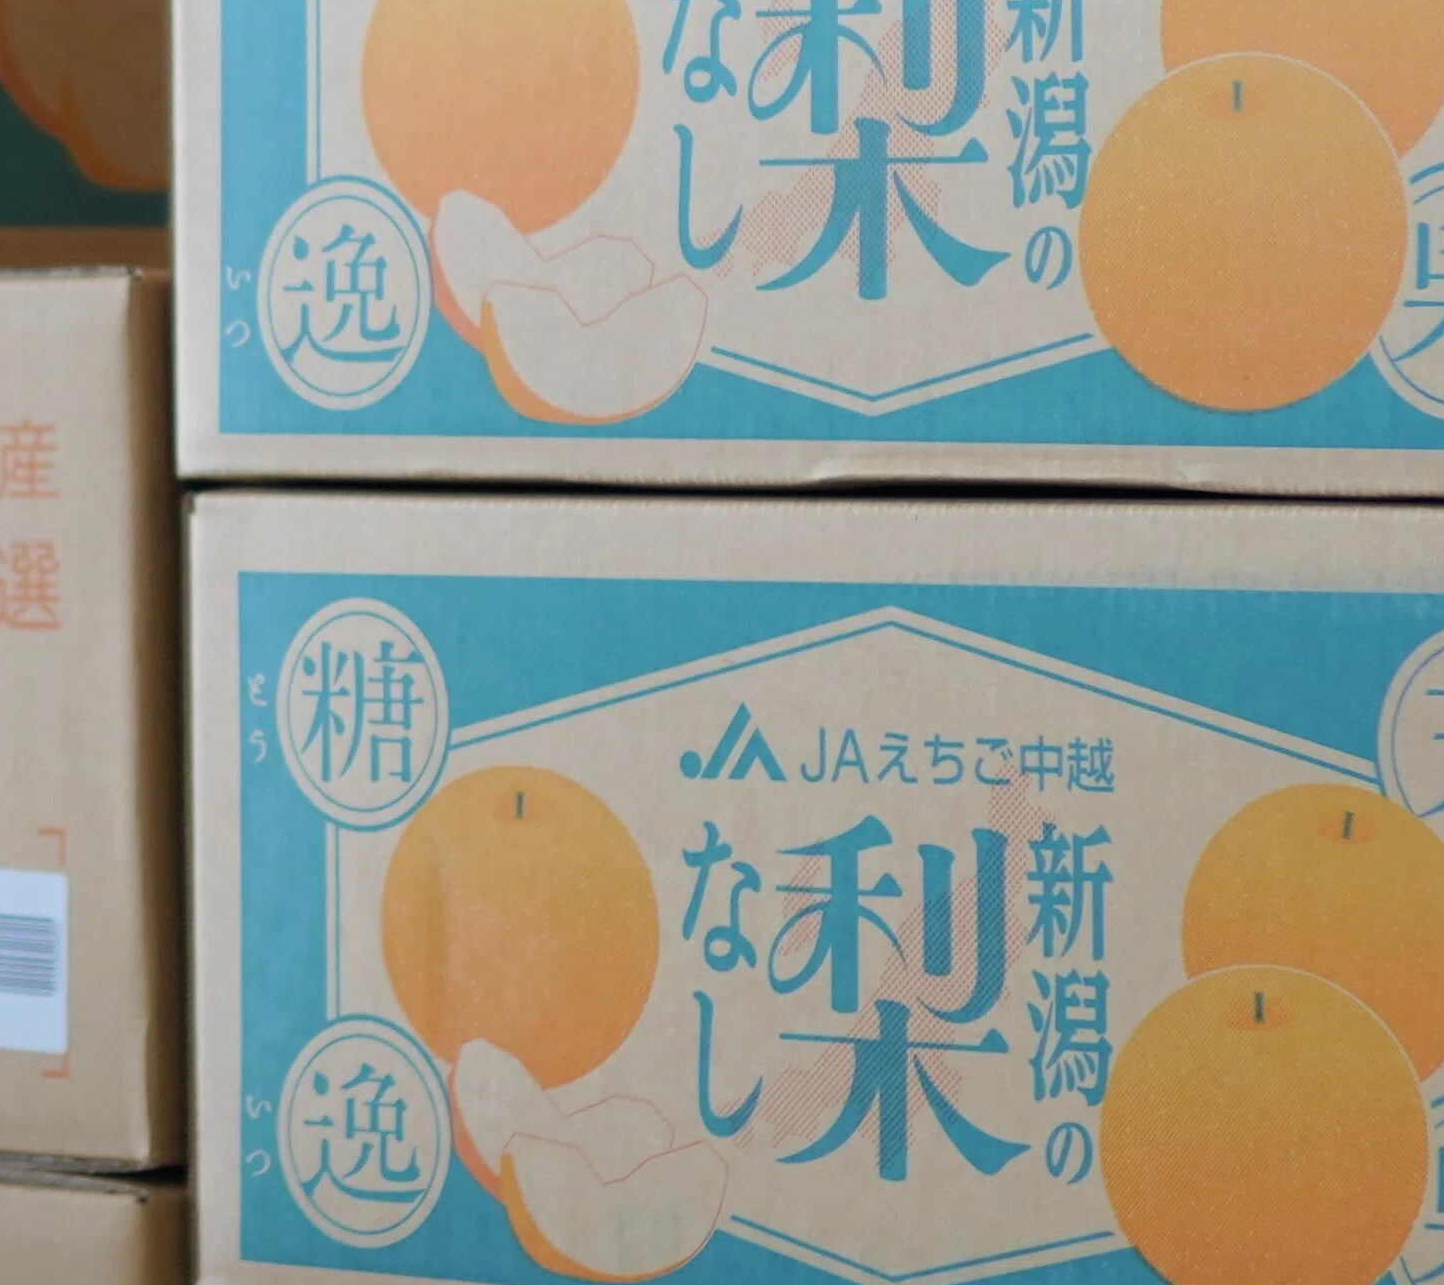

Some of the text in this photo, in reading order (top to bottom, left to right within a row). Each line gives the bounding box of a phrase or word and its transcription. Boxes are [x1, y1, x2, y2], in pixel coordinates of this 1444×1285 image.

[284, 224, 402, 363] 逸
[301, 642, 423, 785] 糖
[800, 728, 1115, 793] JAえちご中越
[681, 821, 763, 1138] なし
[767, 815, 1031, 1181] 梨
[1027, 823, 1113, 1185] 新潟の
[303, 1062, 426, 1205] 逸
